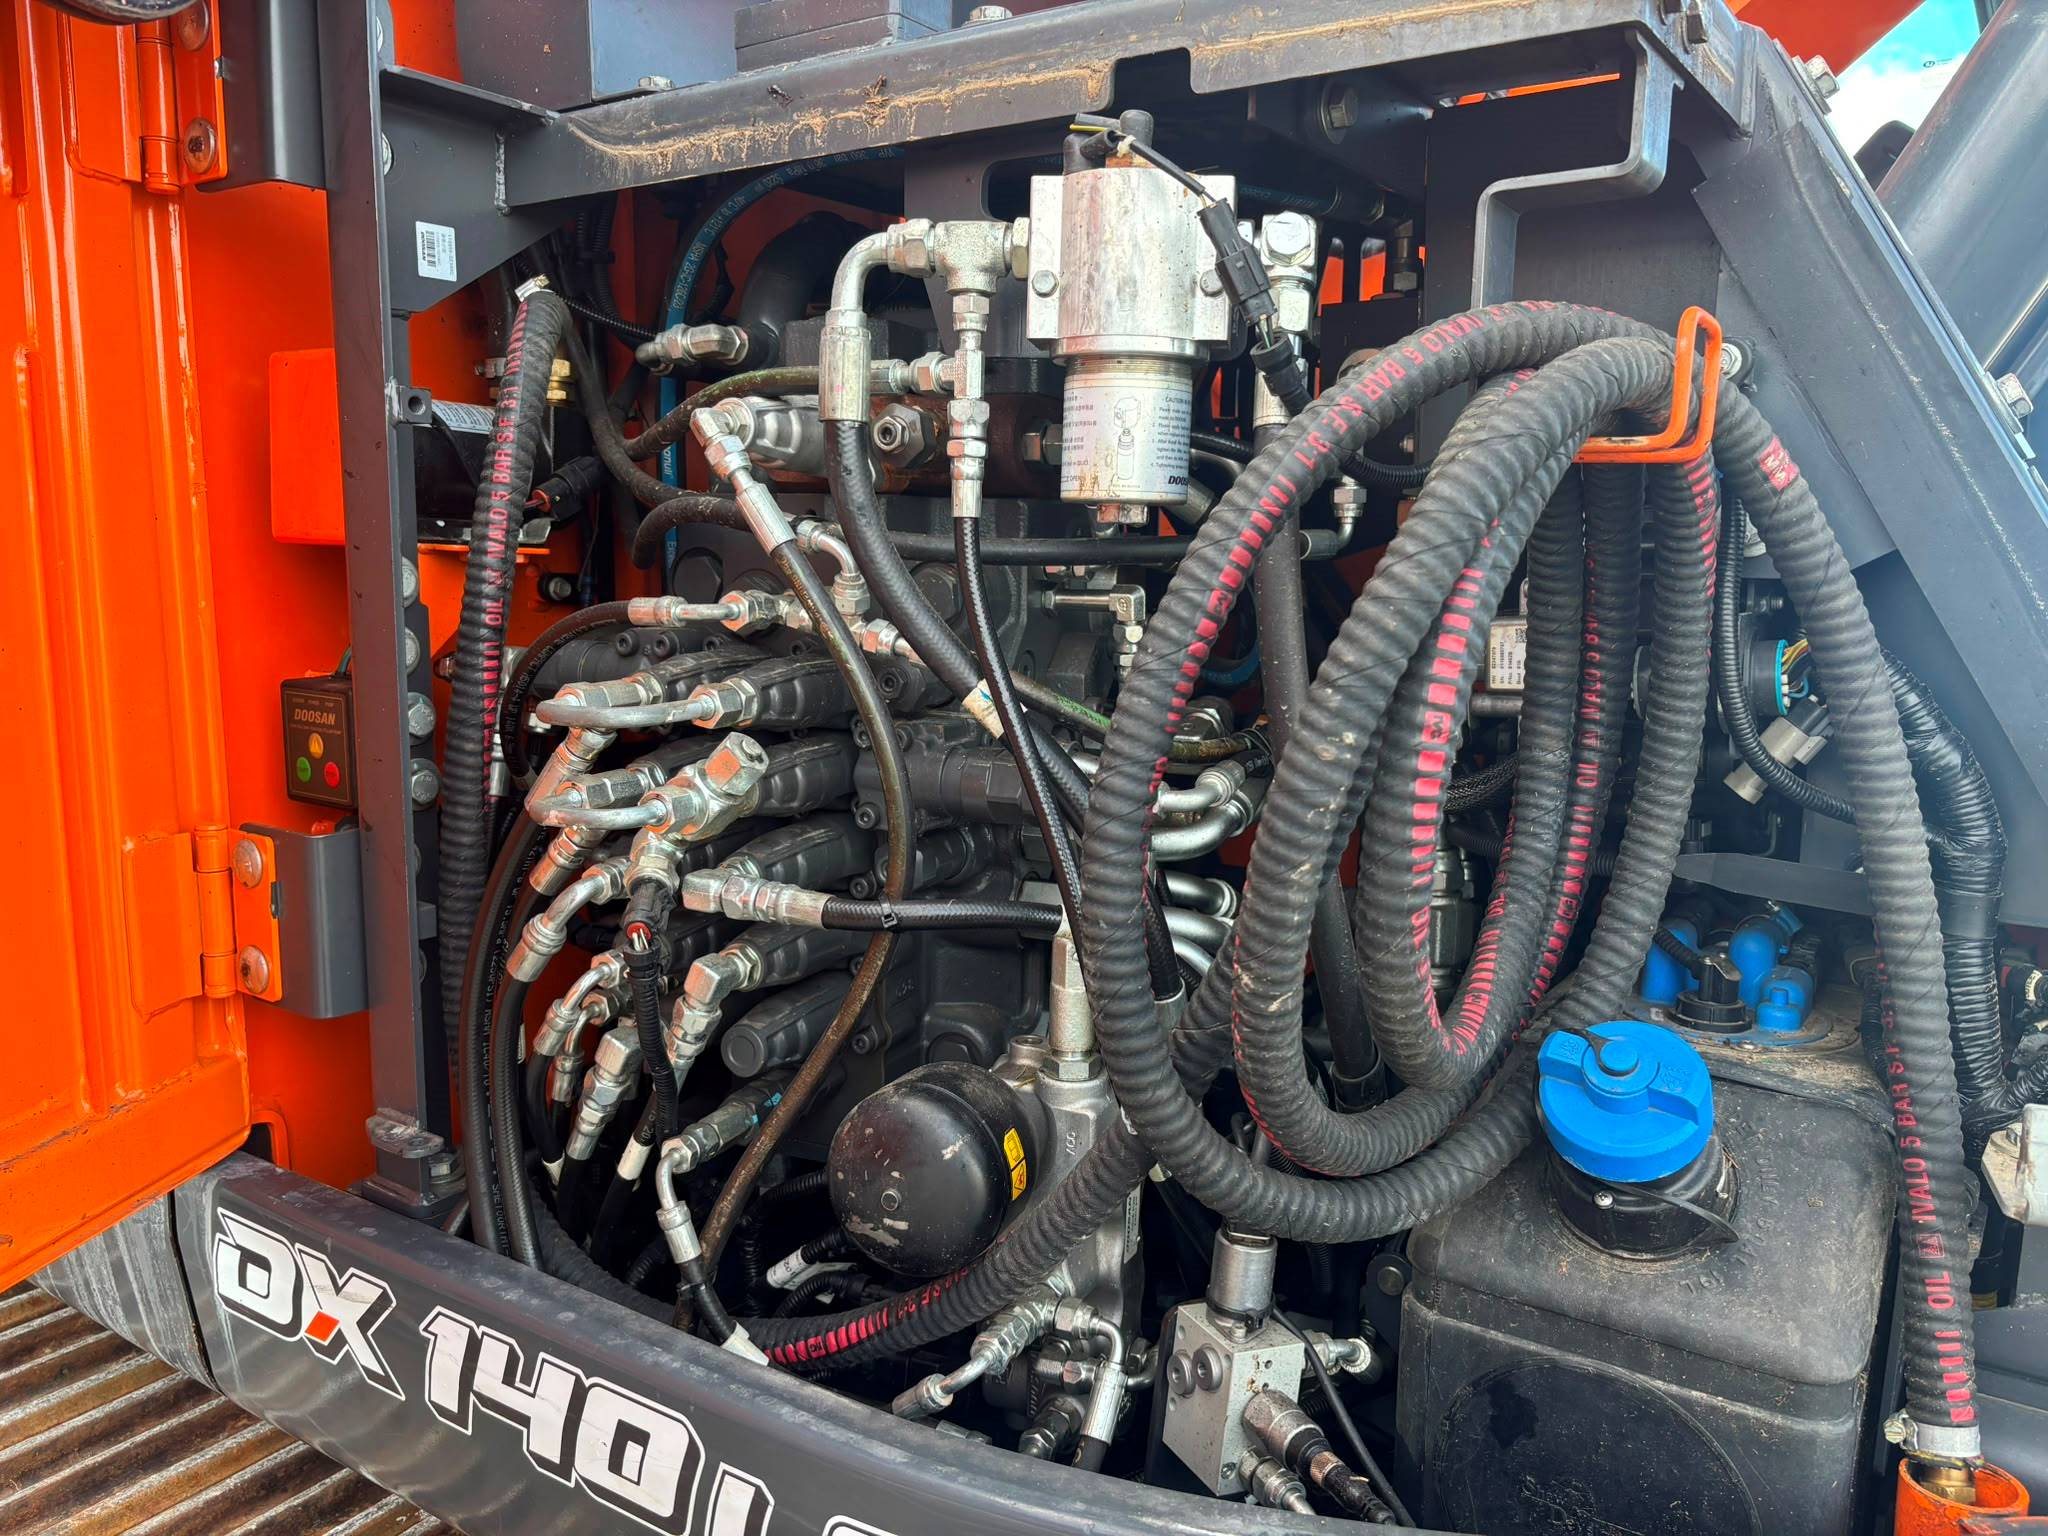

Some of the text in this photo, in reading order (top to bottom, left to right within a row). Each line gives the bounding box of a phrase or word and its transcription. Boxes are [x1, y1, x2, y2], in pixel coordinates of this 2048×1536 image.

[1418, 312, 1485, 353] IVALO
[1402, 346, 1425, 367] 5
[1356, 358, 1408, 402] BAR
[496, 414, 516, 443] S.F.
[1320, 395, 1365, 434] S.F.
[491, 449, 513, 485] BAR
[490, 490, 510, 502] 5
[487, 507, 509, 559] IVALO
[484, 597, 505, 626] OIL
[294, 708, 337, 726] DOOSAN
[1575, 762, 1600, 789] OIL
[1892, 1082, 1918, 1128] BAR
[1899, 1135, 1922, 1149] 5
[1903, 1157, 1938, 1224] IVALO
[212, 1206, 405, 1401] DX
[1924, 1270, 1955, 1310] OIL
